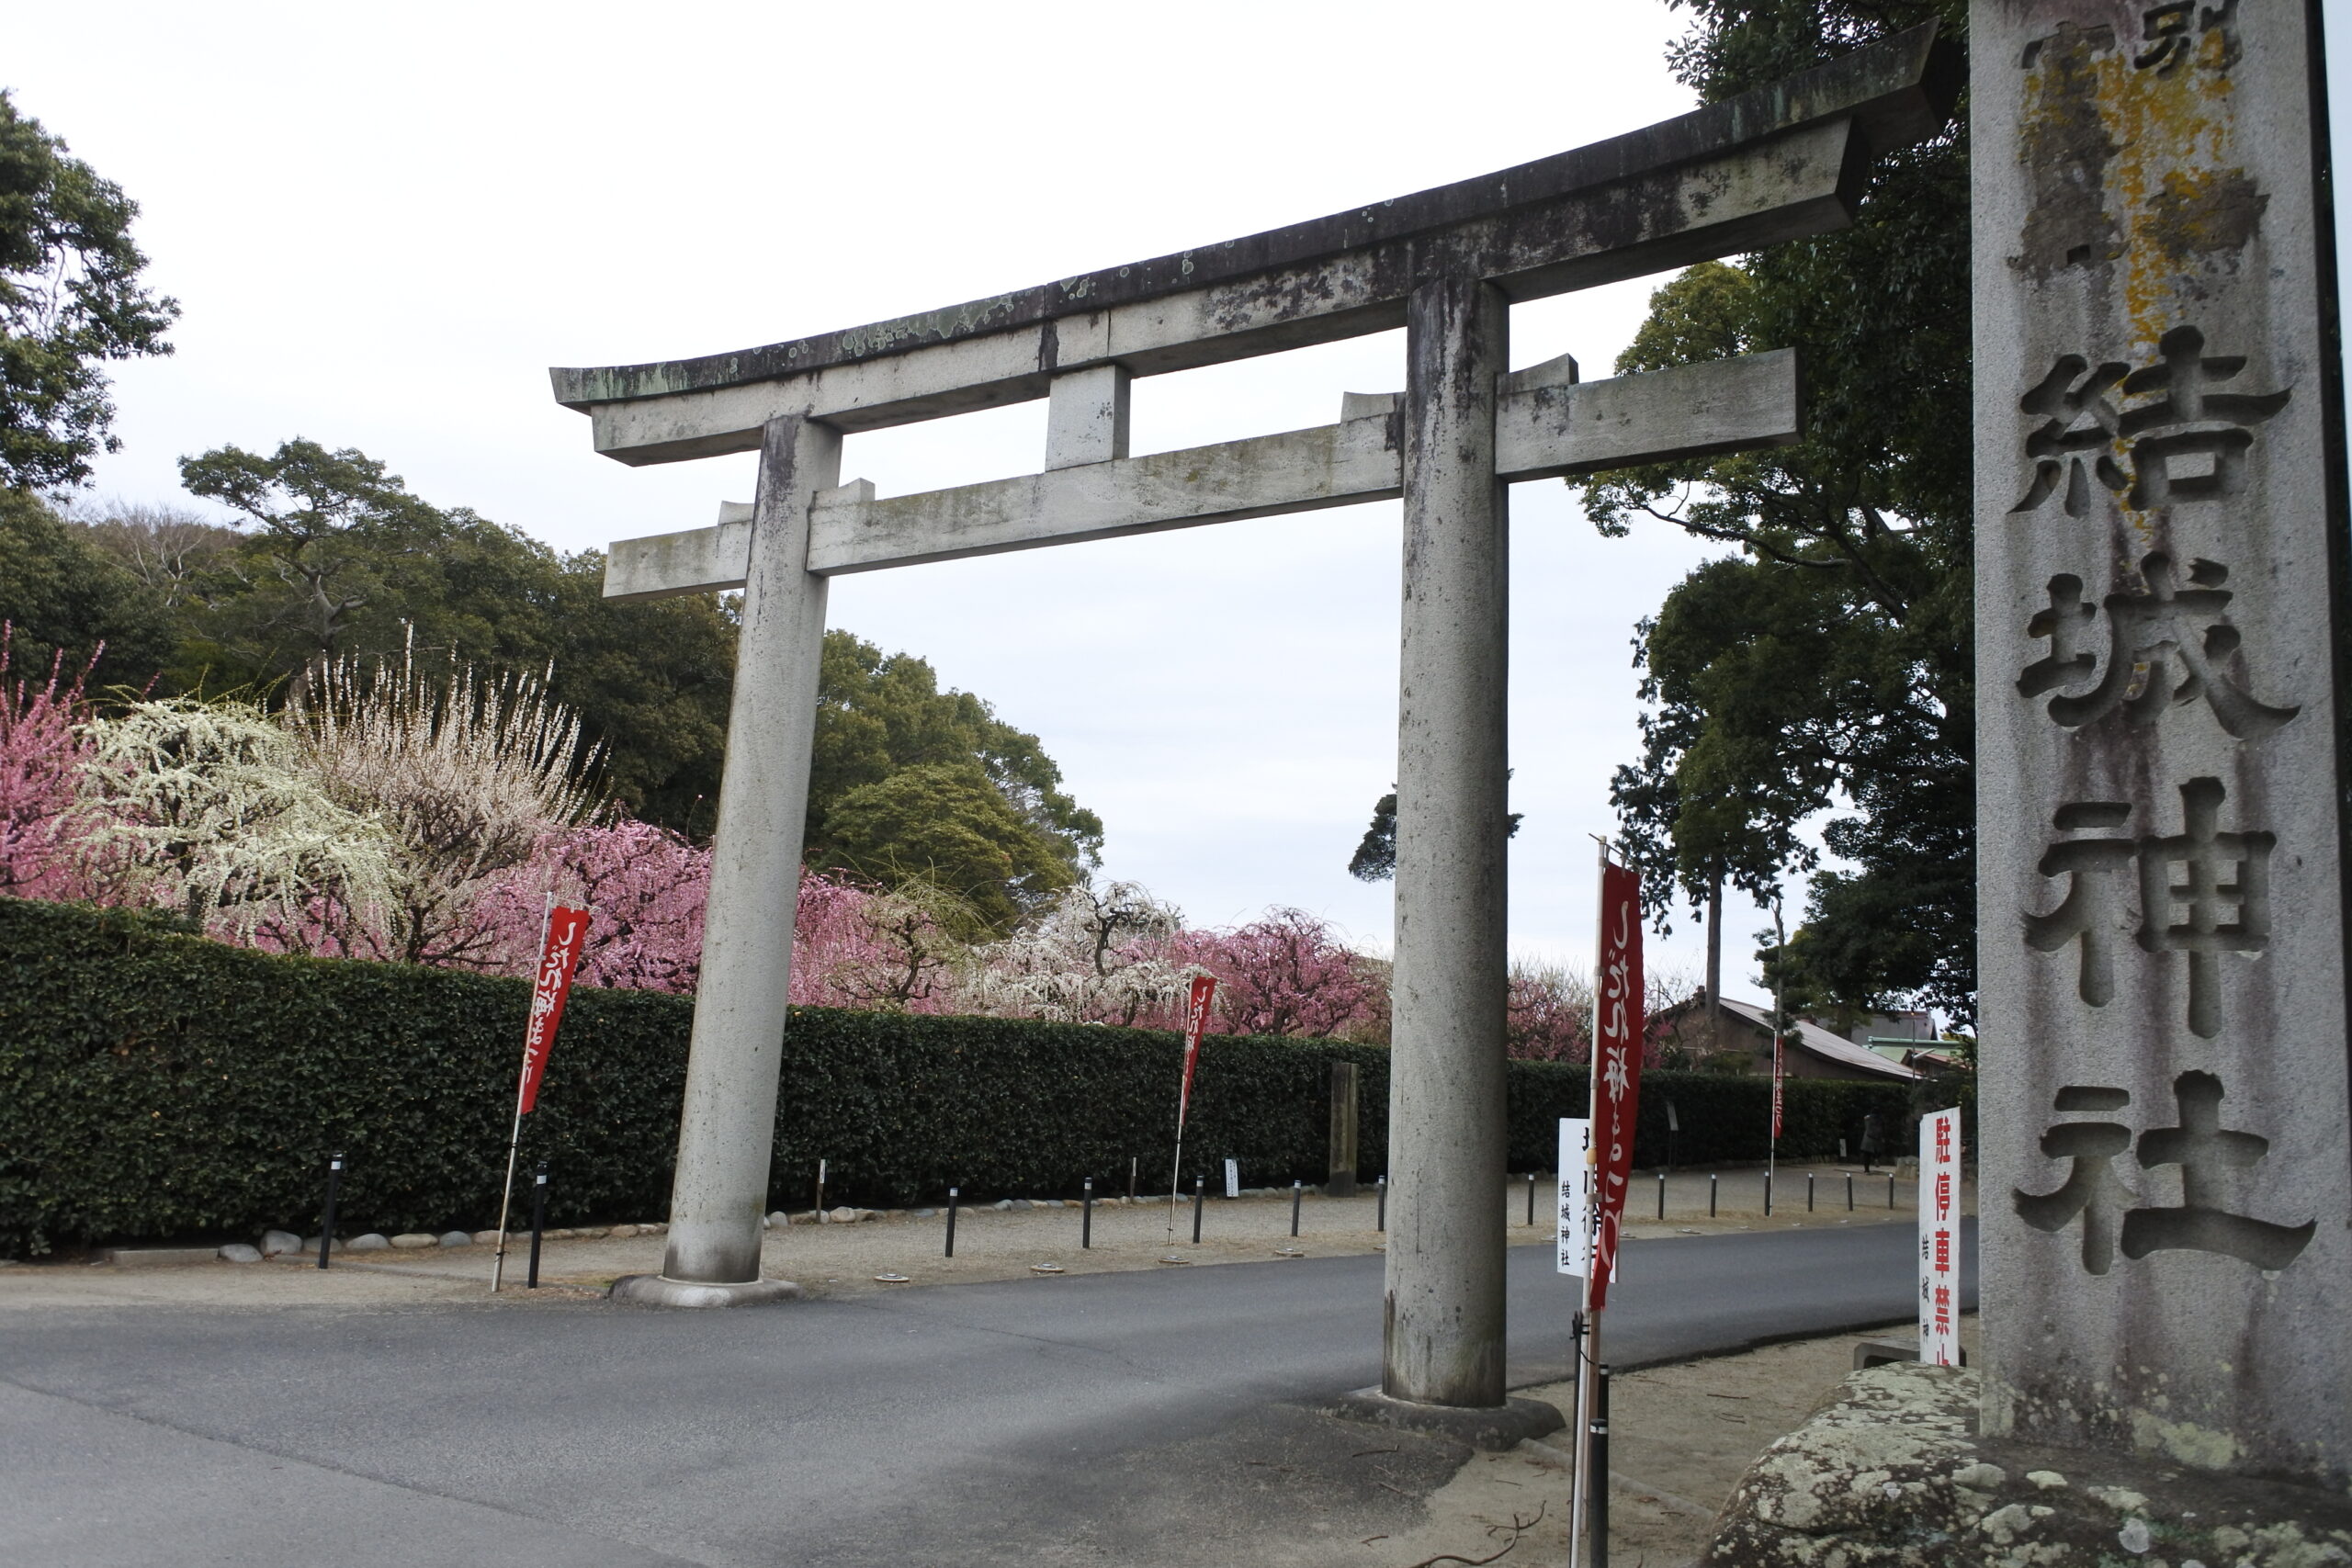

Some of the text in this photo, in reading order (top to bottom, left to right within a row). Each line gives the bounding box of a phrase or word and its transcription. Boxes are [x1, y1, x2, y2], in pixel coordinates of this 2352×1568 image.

[2007, 325, 2317, 1276] 結城神社
[1561, 1180, 1570, 1267] 結城神社
[1921, 1234, 1930, 1363] 結城神
